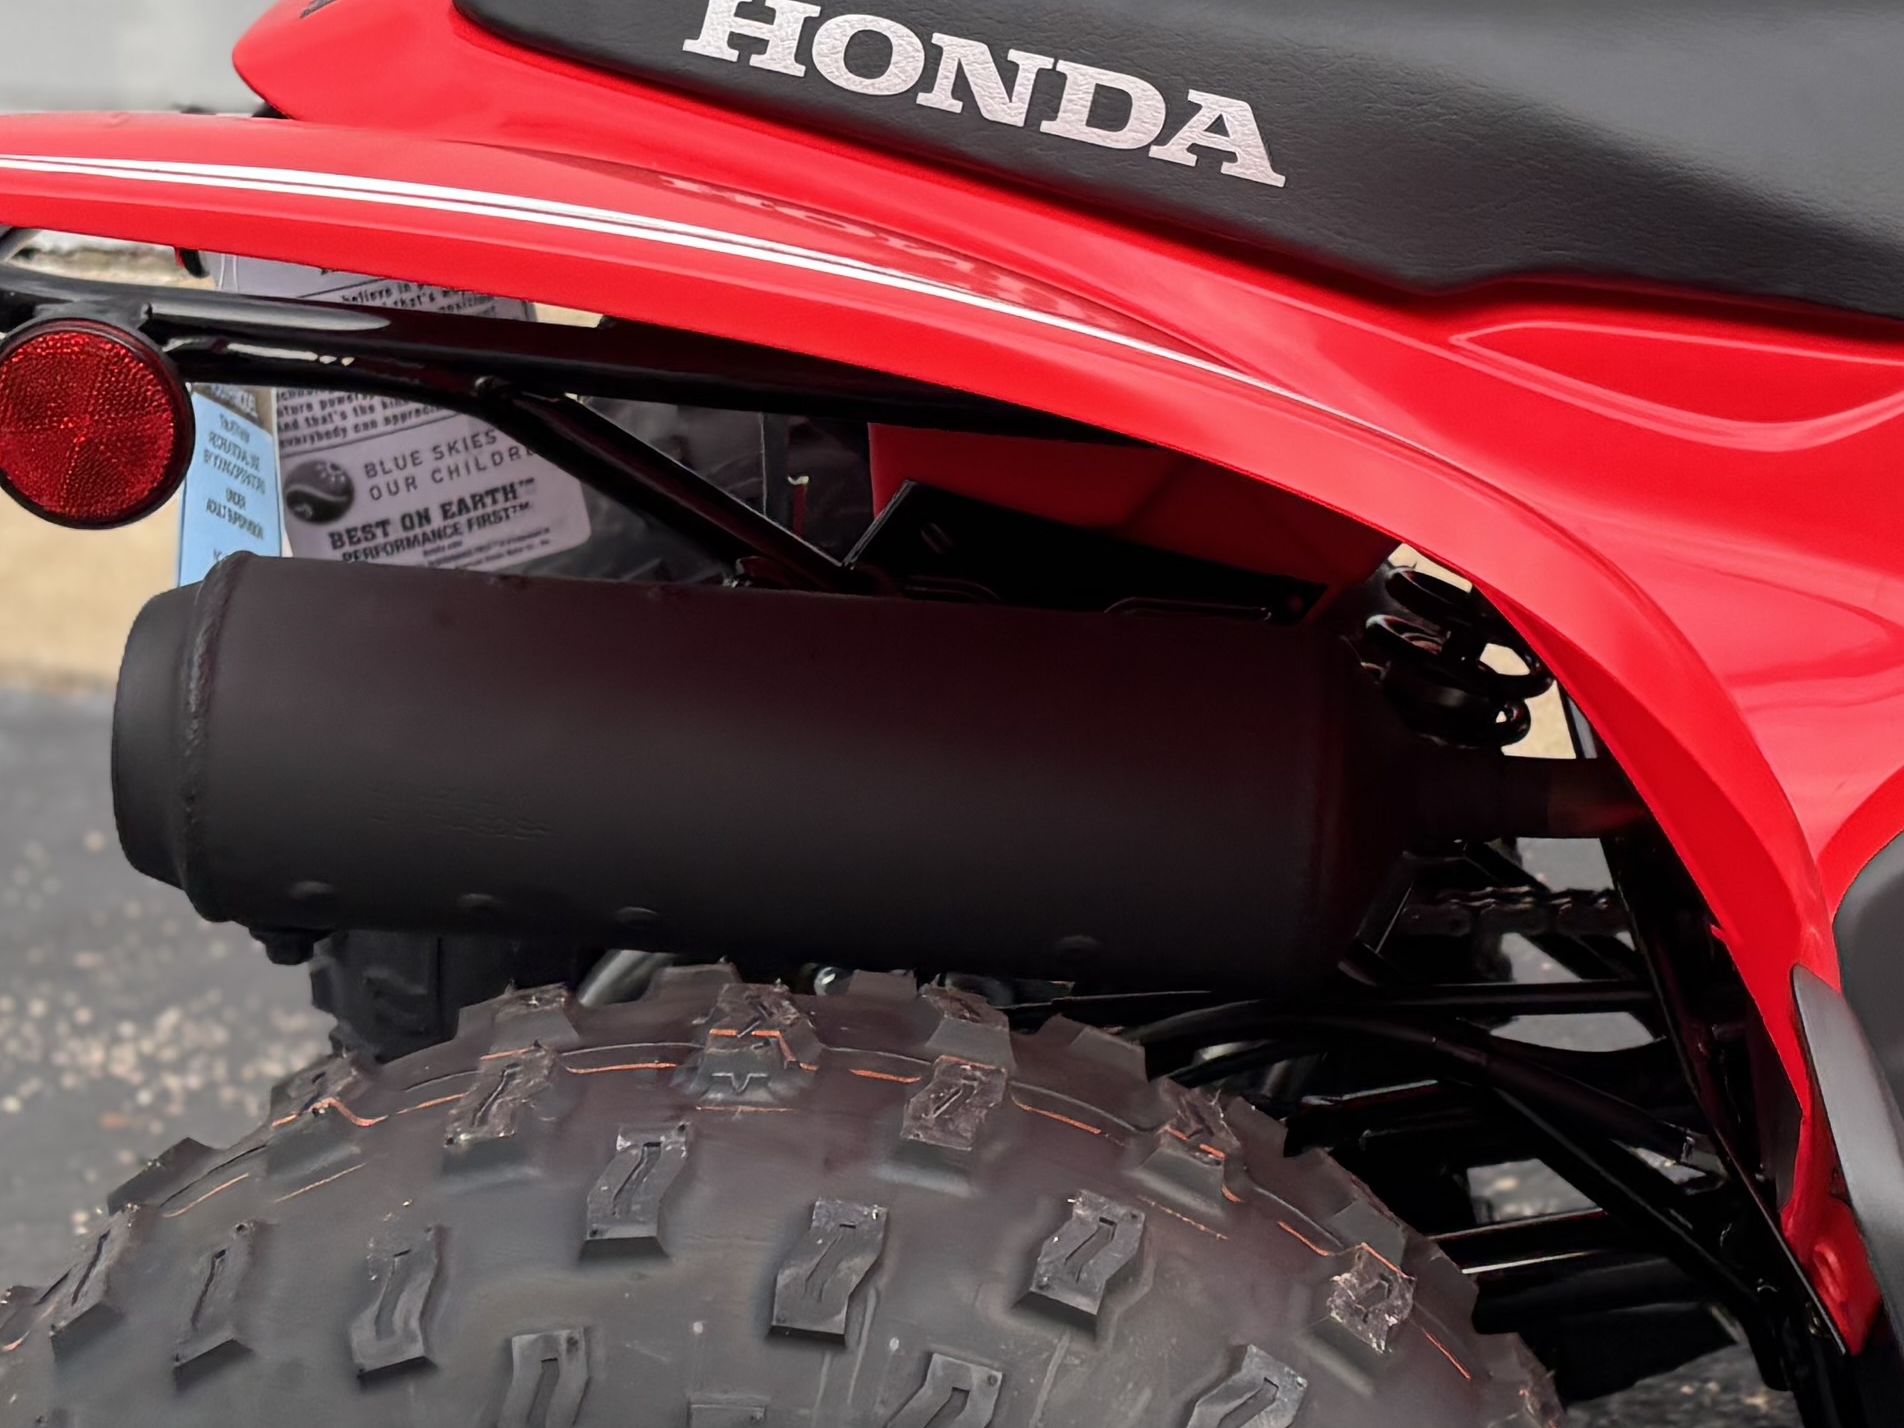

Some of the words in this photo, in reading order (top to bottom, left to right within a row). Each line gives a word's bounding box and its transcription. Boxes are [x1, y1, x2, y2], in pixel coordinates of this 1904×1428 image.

[364, 450, 424, 479] BLUE
[432, 428, 498, 462] SKIES
[369, 475, 419, 502] OUR
[328, 518, 391, 551] BEST
[401, 506, 433, 533] ON
[342, 520, 464, 563] PERFORMANCE
